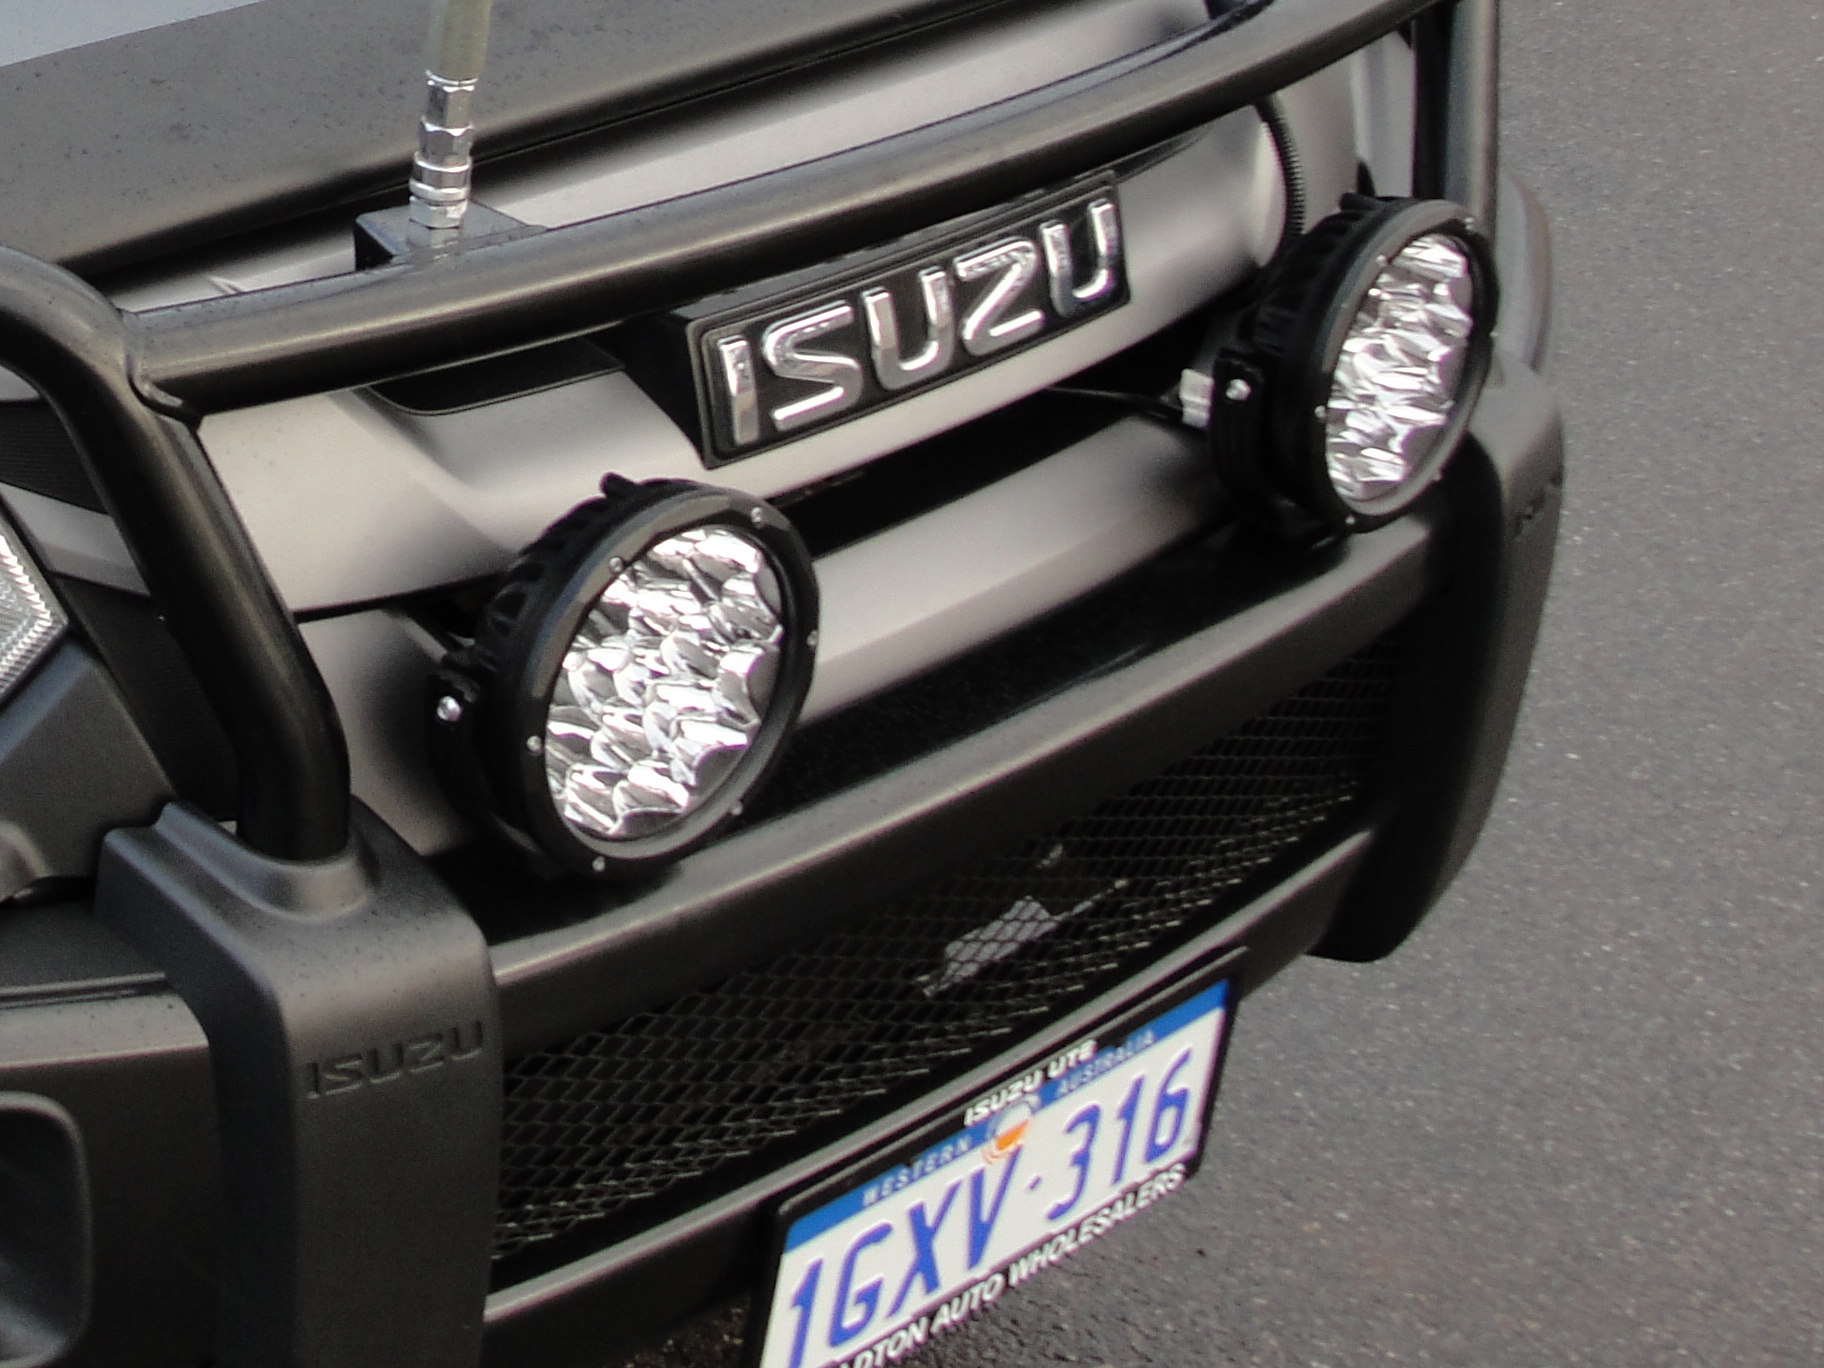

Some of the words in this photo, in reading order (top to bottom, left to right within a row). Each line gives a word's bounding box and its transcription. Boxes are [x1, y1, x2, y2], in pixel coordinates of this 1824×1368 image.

[717, 197, 1118, 446] ISUZU
[307, 1020, 483, 1099] ISUZU
[862, 1135, 972, 1208] WESTERN
[1055, 1029, 1156, 1099] AUSTRALIA
[963, 1068, 1044, 1127] ISUZU
[1047, 1038, 1098, 1080] UTE
[929, 1272, 1004, 1334] AUTO
[1009, 1161, 1187, 1287] WHOLESALERS
